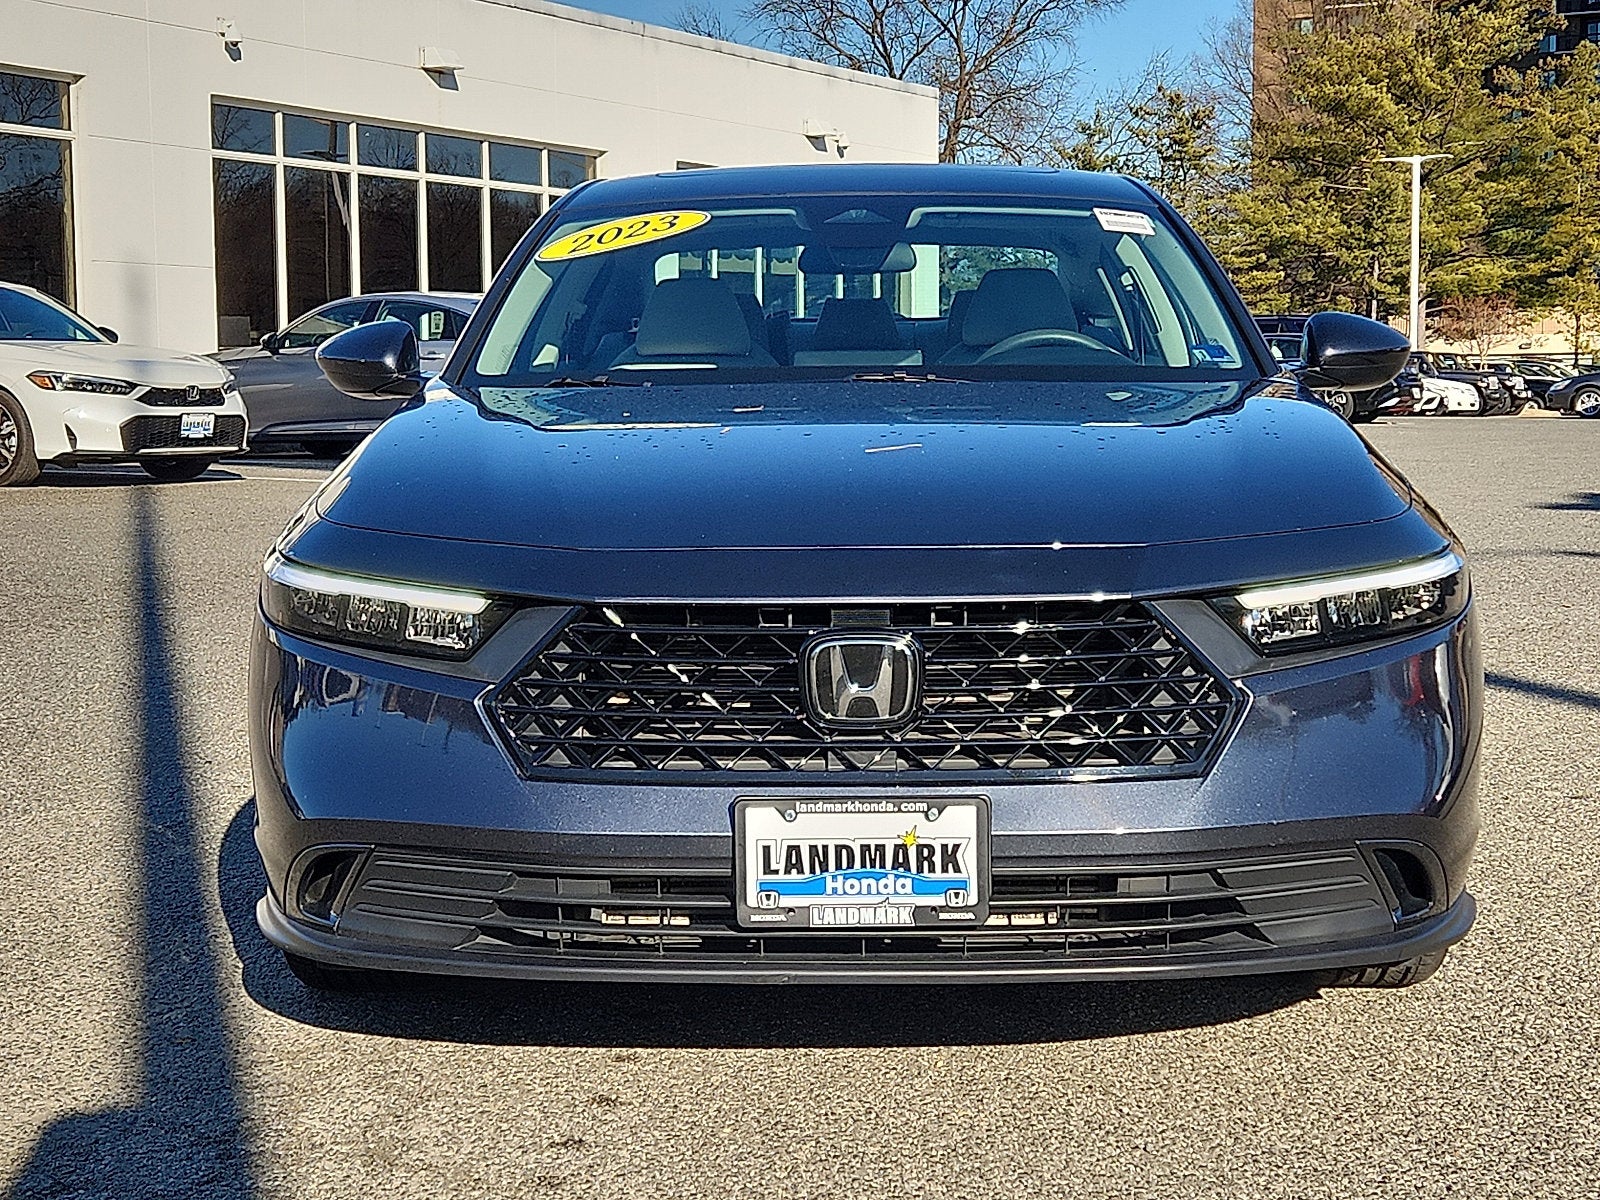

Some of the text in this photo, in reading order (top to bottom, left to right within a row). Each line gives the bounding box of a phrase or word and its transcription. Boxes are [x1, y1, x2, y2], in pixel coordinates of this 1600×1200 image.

[567, 215, 681, 255] 2023
[762, 842, 963, 876] LANDMARK
[825, 874, 914, 895] Honda
[811, 905, 915, 925] LANDMARK
